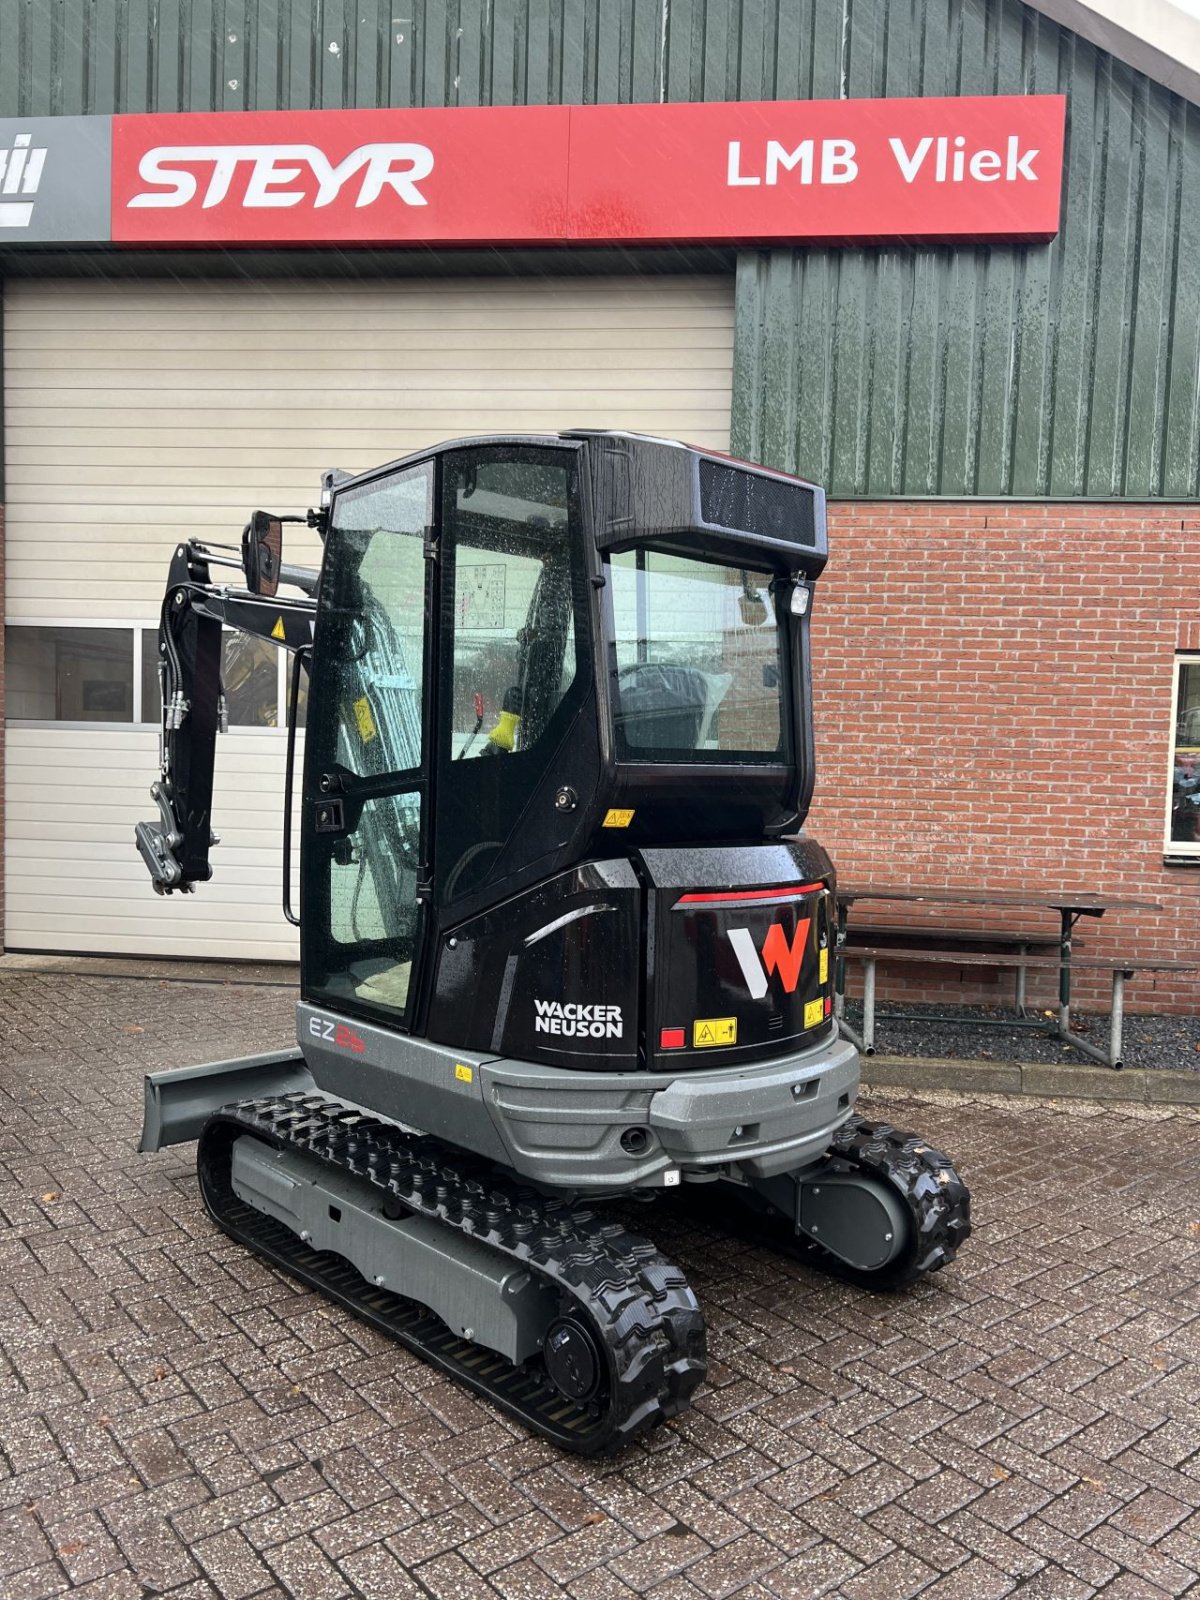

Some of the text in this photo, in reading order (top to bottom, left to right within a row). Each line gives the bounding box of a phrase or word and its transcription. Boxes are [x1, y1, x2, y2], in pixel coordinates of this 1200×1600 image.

[127, 143, 434, 208] STEYR
[727, 136, 1040, 186] LMB Vliek
[534, 999, 623, 1021] WACKER
[535, 1016, 623, 1038] NEUSON
